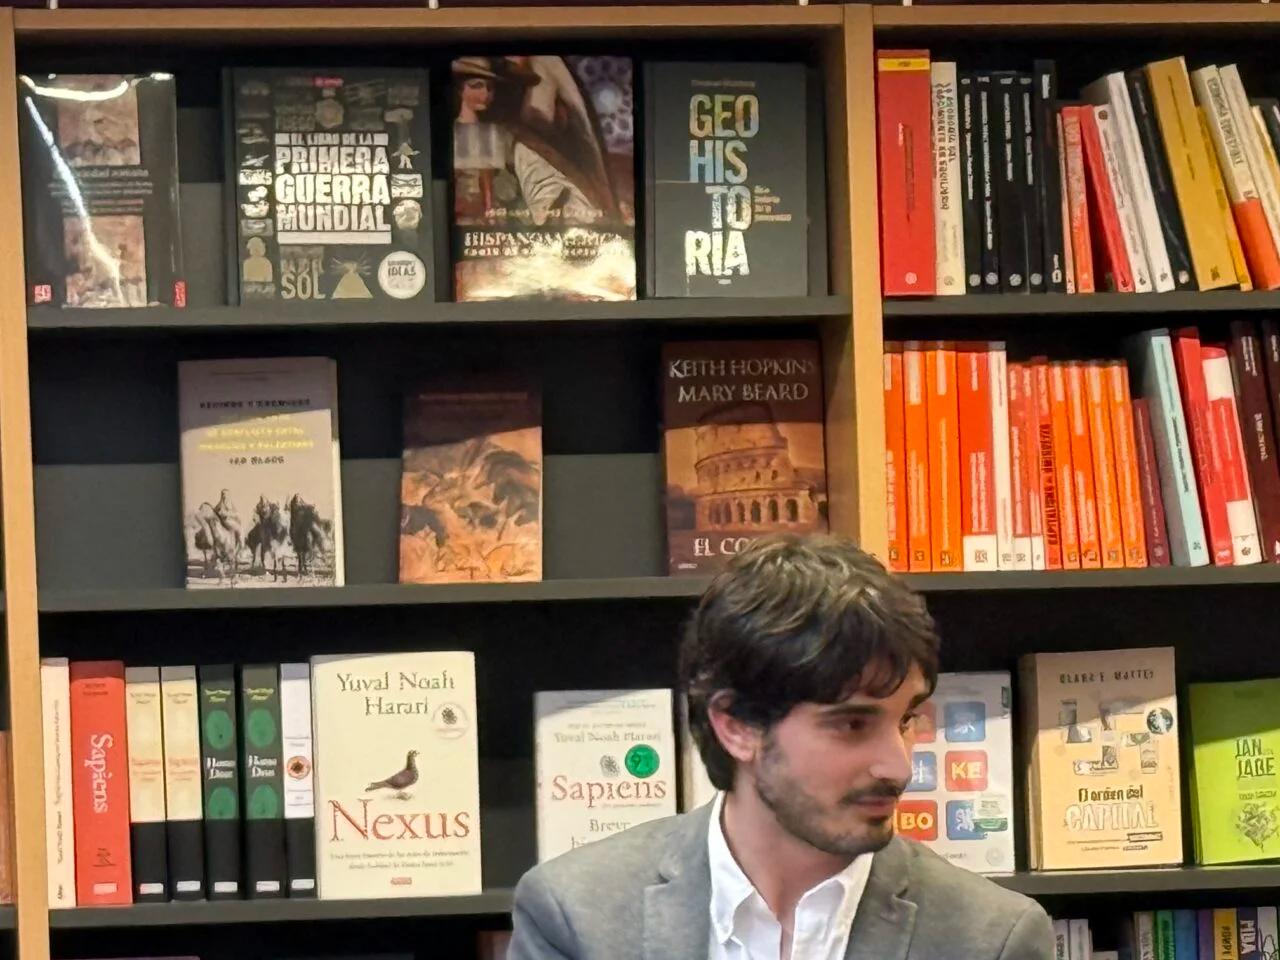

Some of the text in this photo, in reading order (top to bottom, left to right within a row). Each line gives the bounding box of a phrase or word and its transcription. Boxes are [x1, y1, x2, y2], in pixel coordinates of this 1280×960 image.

[689, 94, 759, 138] GEO
[275, 146, 390, 174] PRIMERA
[690, 140, 748, 184] HIS
[275, 174, 391, 205] GUERRA
[276, 205, 391, 232] MUNDIAL
[705, 185, 752, 230] TO
[685, 231, 750, 277] RIA
[669, 359, 726, 378] KEITH
[678, 383, 809, 403] MARY BEARD
[694, 538, 715, 557] EL
[336, 671, 456, 692] Yuval Noah
[366, 697, 429, 717] Harari
[84, 733, 115, 814] Sapiens
[552, 775, 667, 808] Sapiens
[329, 799, 471, 843] Nexus
[1064, 801, 1159, 831] CAPITAL
